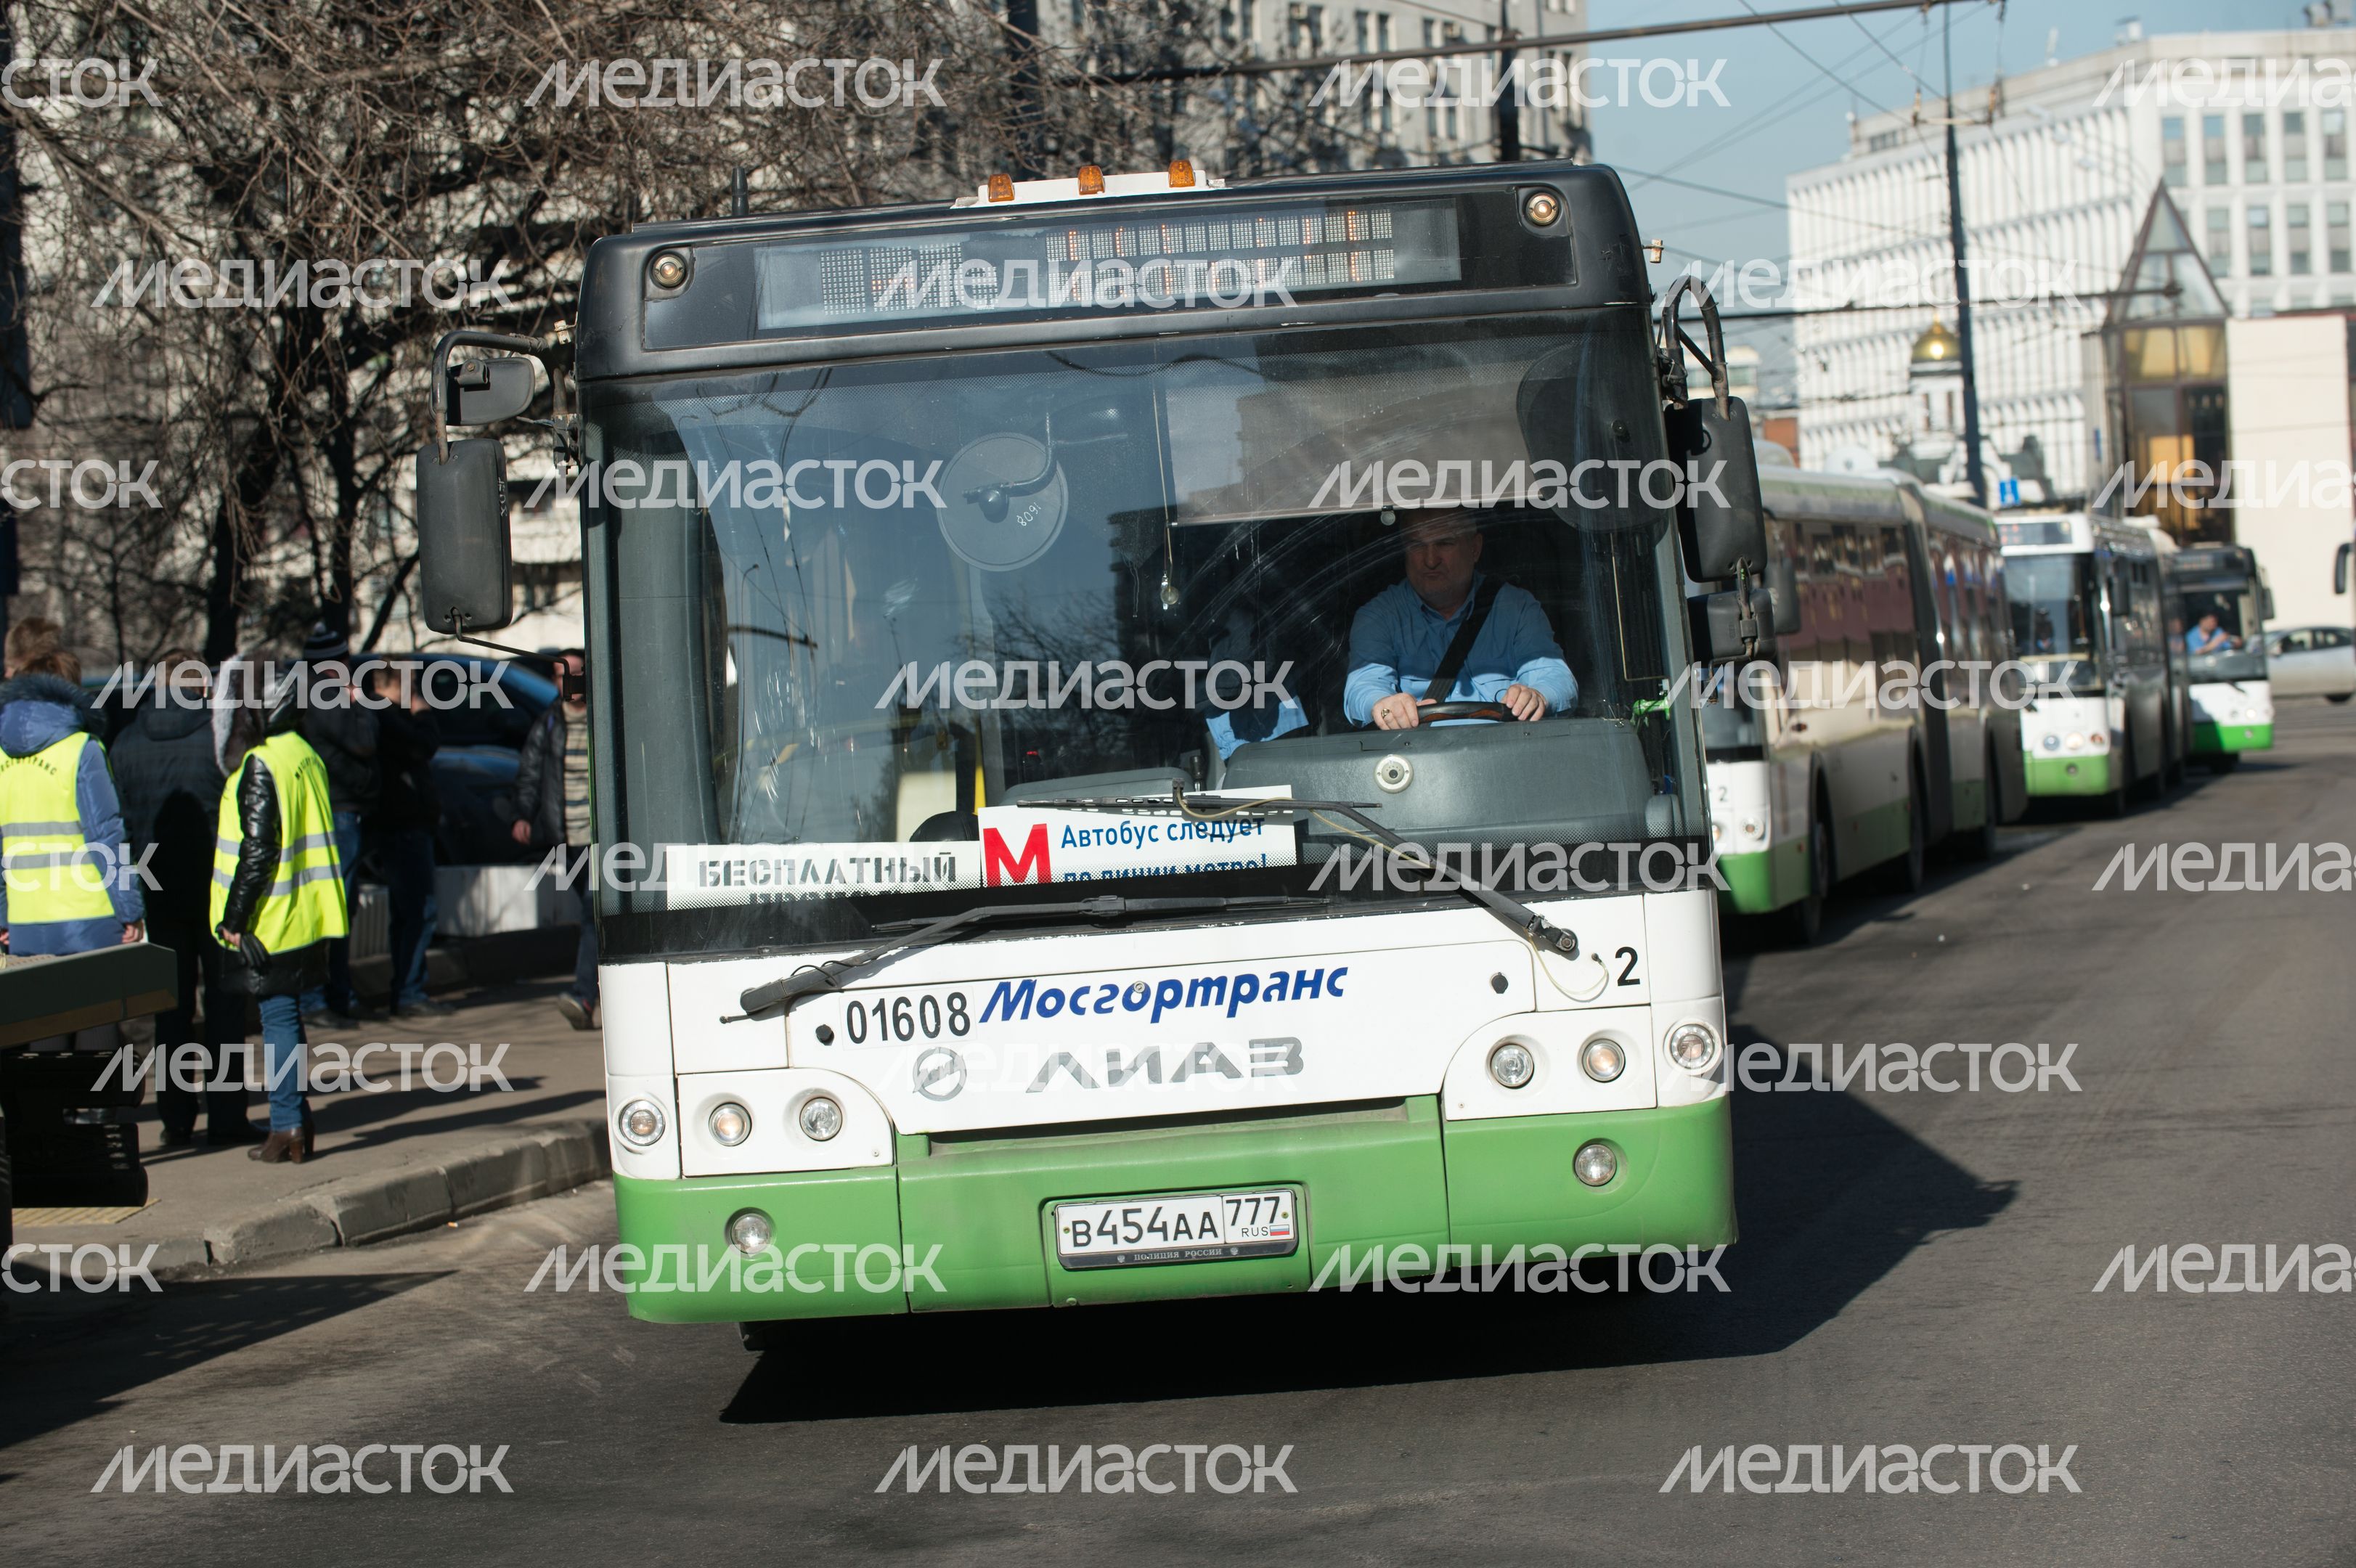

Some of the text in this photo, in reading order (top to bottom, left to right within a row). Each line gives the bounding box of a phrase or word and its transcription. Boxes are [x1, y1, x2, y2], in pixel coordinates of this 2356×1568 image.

[1061, 820, 1158, 849] Автобус
[1167, 817, 1265, 844] следует
[699, 852, 956, 887] БЕСПЛАТНЫЙ
[1615, 946, 1641, 987] 2
[979, 967, 1348, 1024] Мосгортранс
[847, 992, 971, 1044] 01608
[1242, 1226, 1269, 1238] RUS
[1134, 1248, 1223, 1261] ПОЛИЦИЯ РОССИИ
